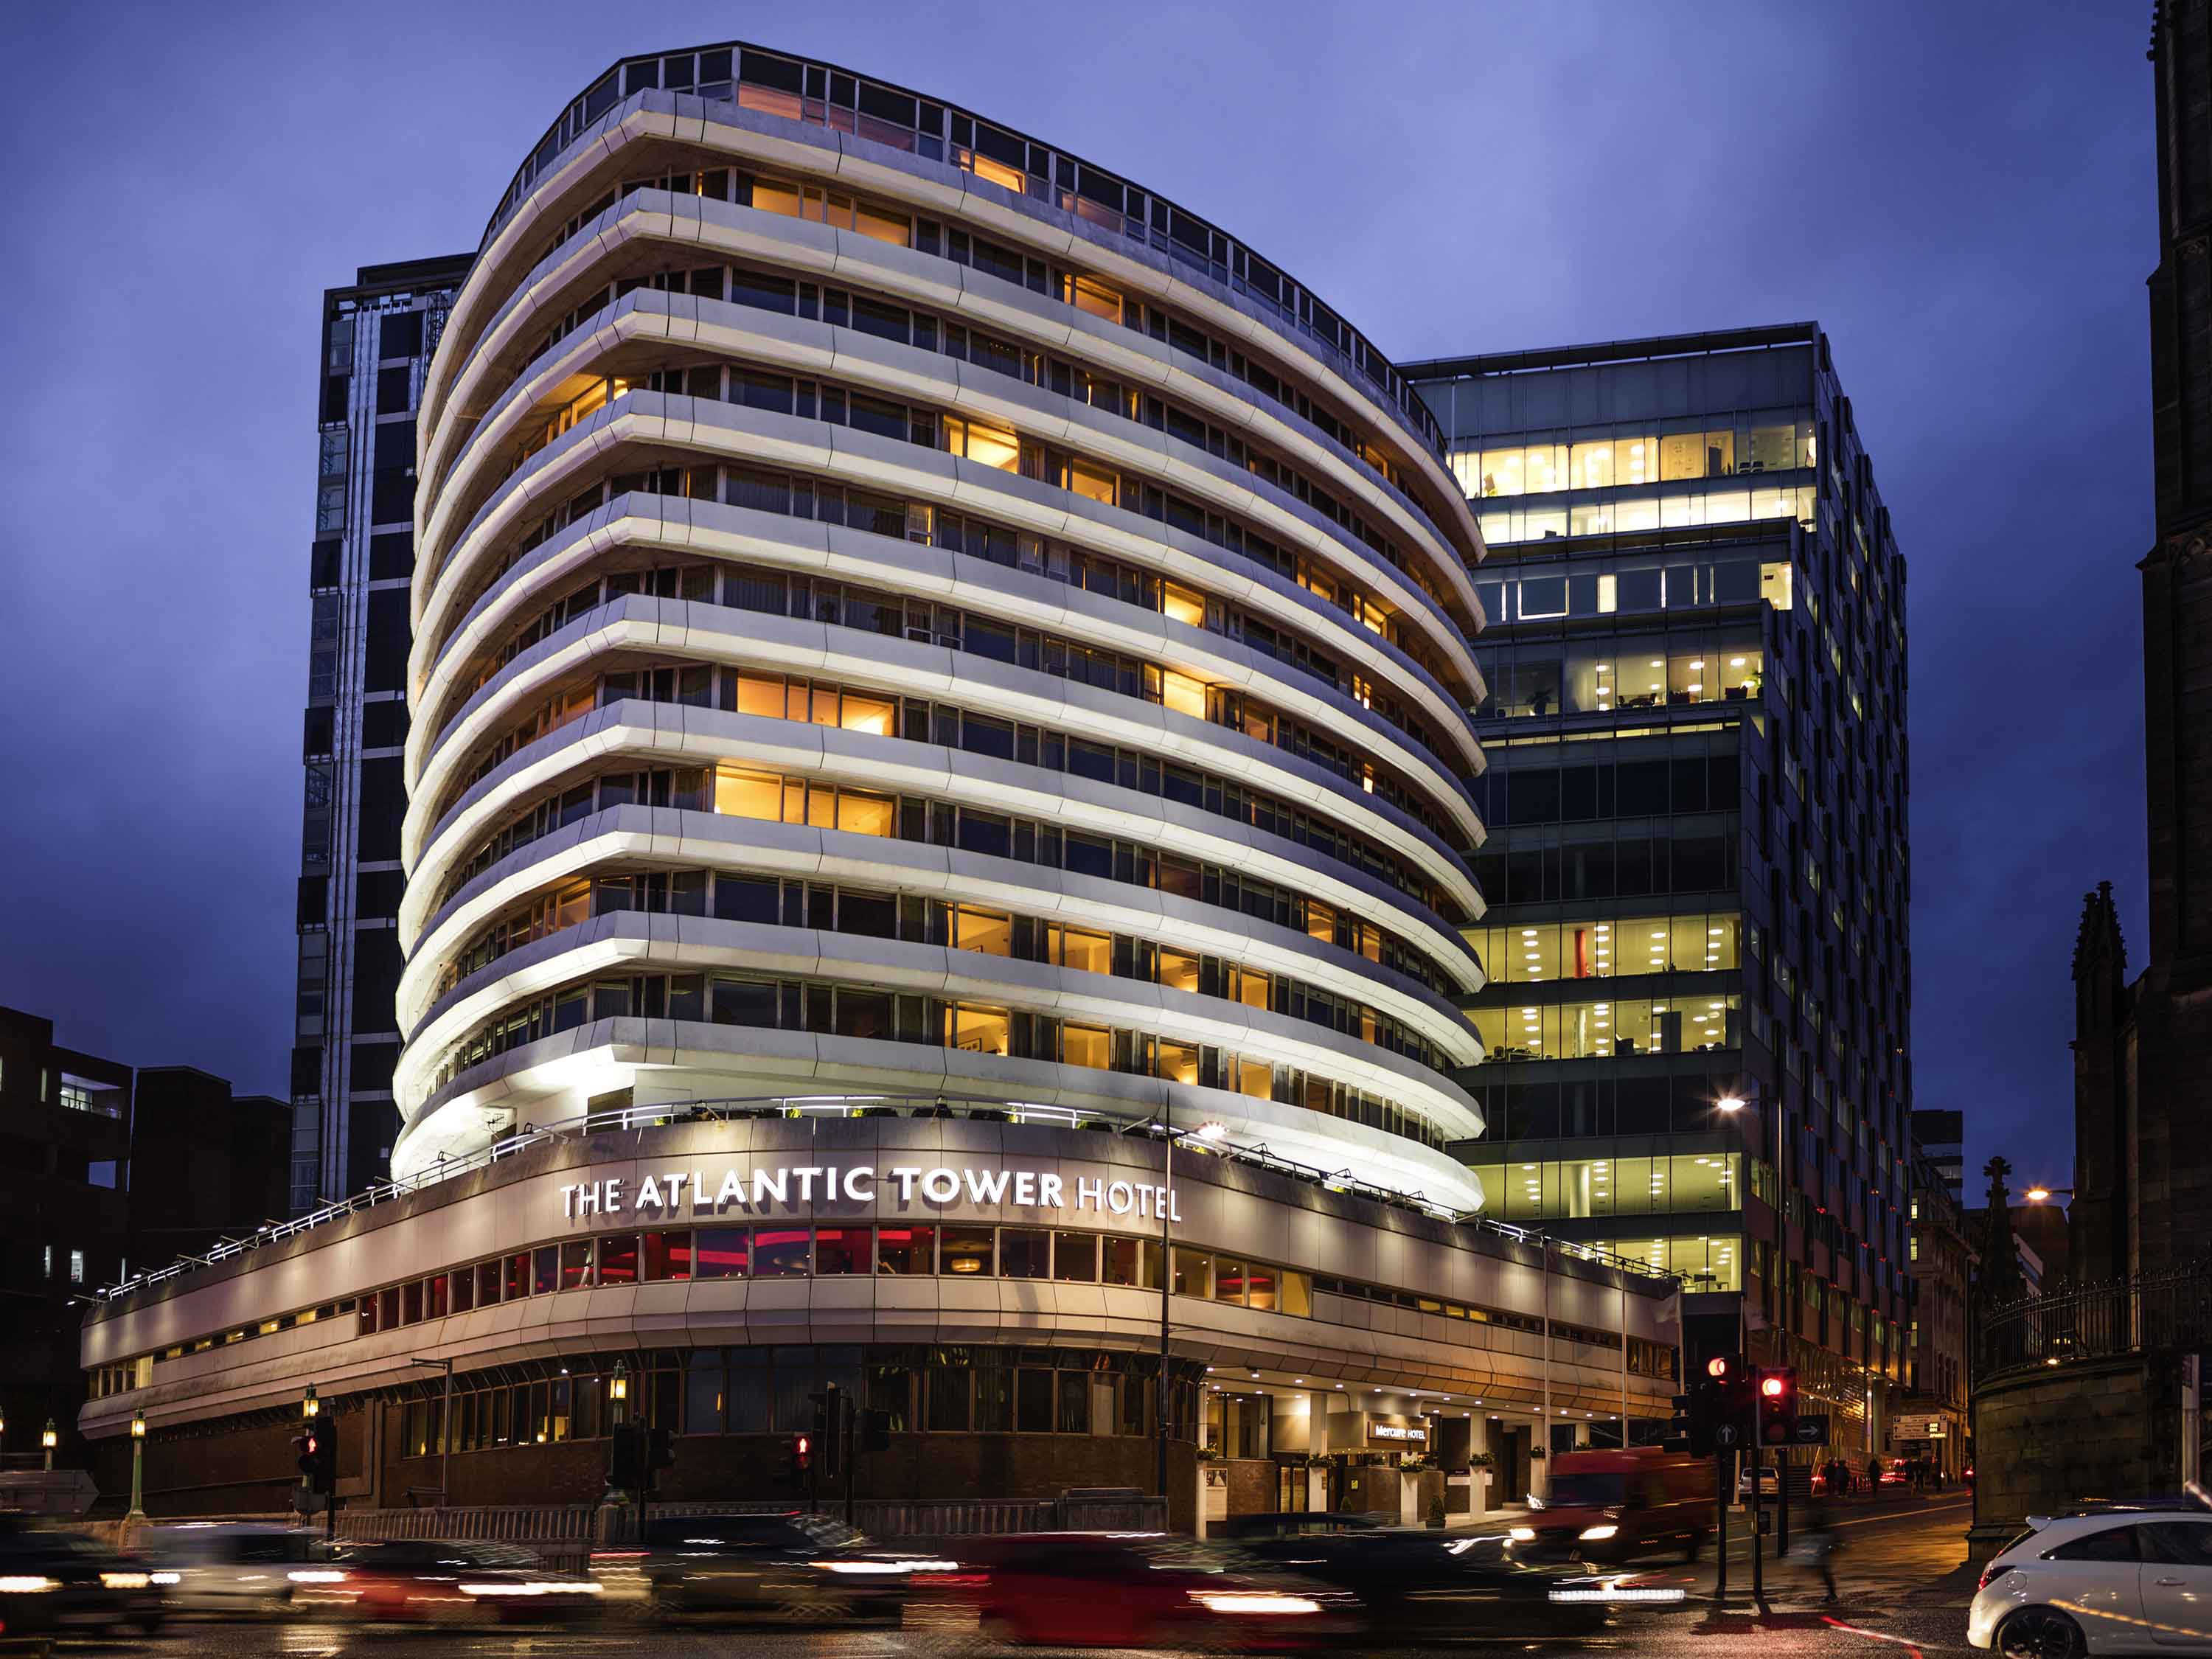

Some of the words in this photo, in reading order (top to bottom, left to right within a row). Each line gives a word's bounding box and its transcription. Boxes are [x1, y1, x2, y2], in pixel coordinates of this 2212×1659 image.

[560, 1179, 624, 1217] THE
[635, 1167, 875, 1208] ATLANTIC
[892, 1167, 1064, 1208] TOWER
[1076, 1177, 1181, 1221] HOTEL
[1376, 1425, 1406, 1438] Mercure
[1408, 1430, 1425, 1439] HOTEL
